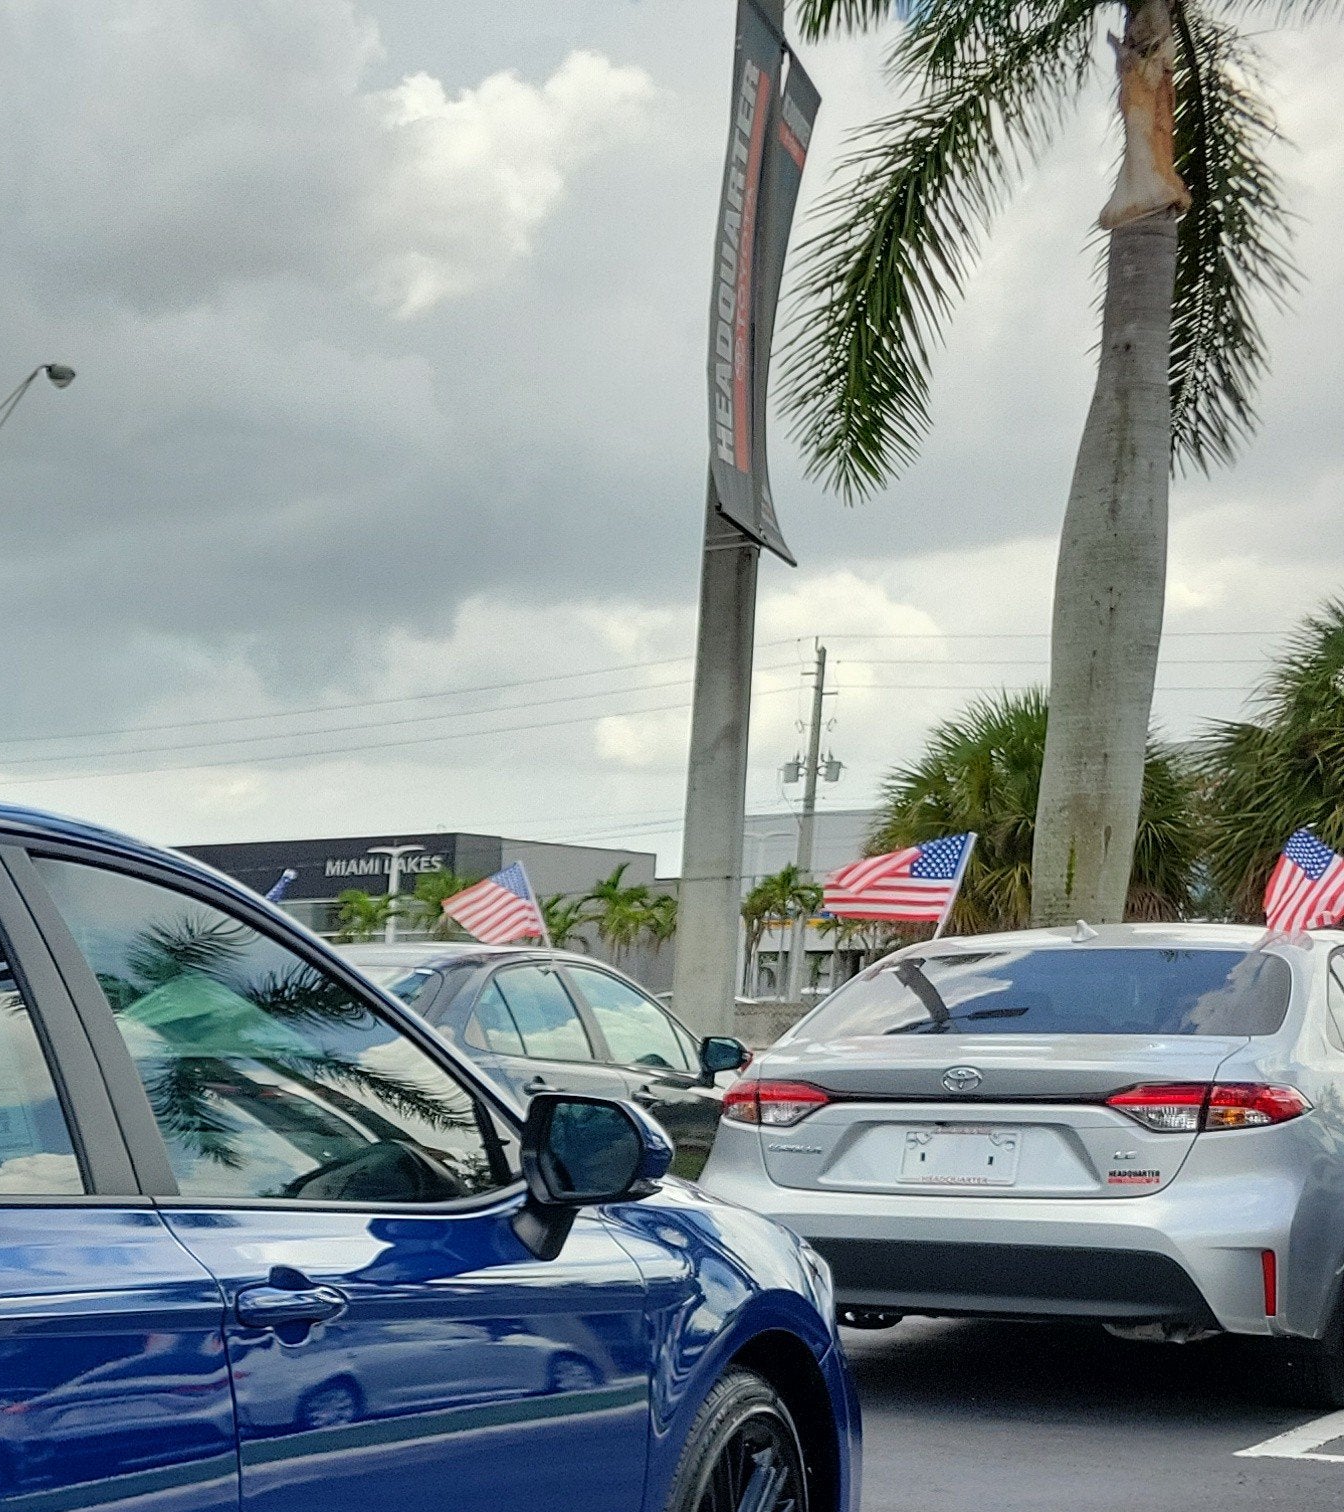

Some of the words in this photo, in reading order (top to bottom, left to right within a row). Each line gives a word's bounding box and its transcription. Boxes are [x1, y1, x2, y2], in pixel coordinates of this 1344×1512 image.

[715, 59, 760, 470] HEADQUARTER
[325, 857, 381, 876] MIAMI
[383, 855, 442, 874] LAKES
